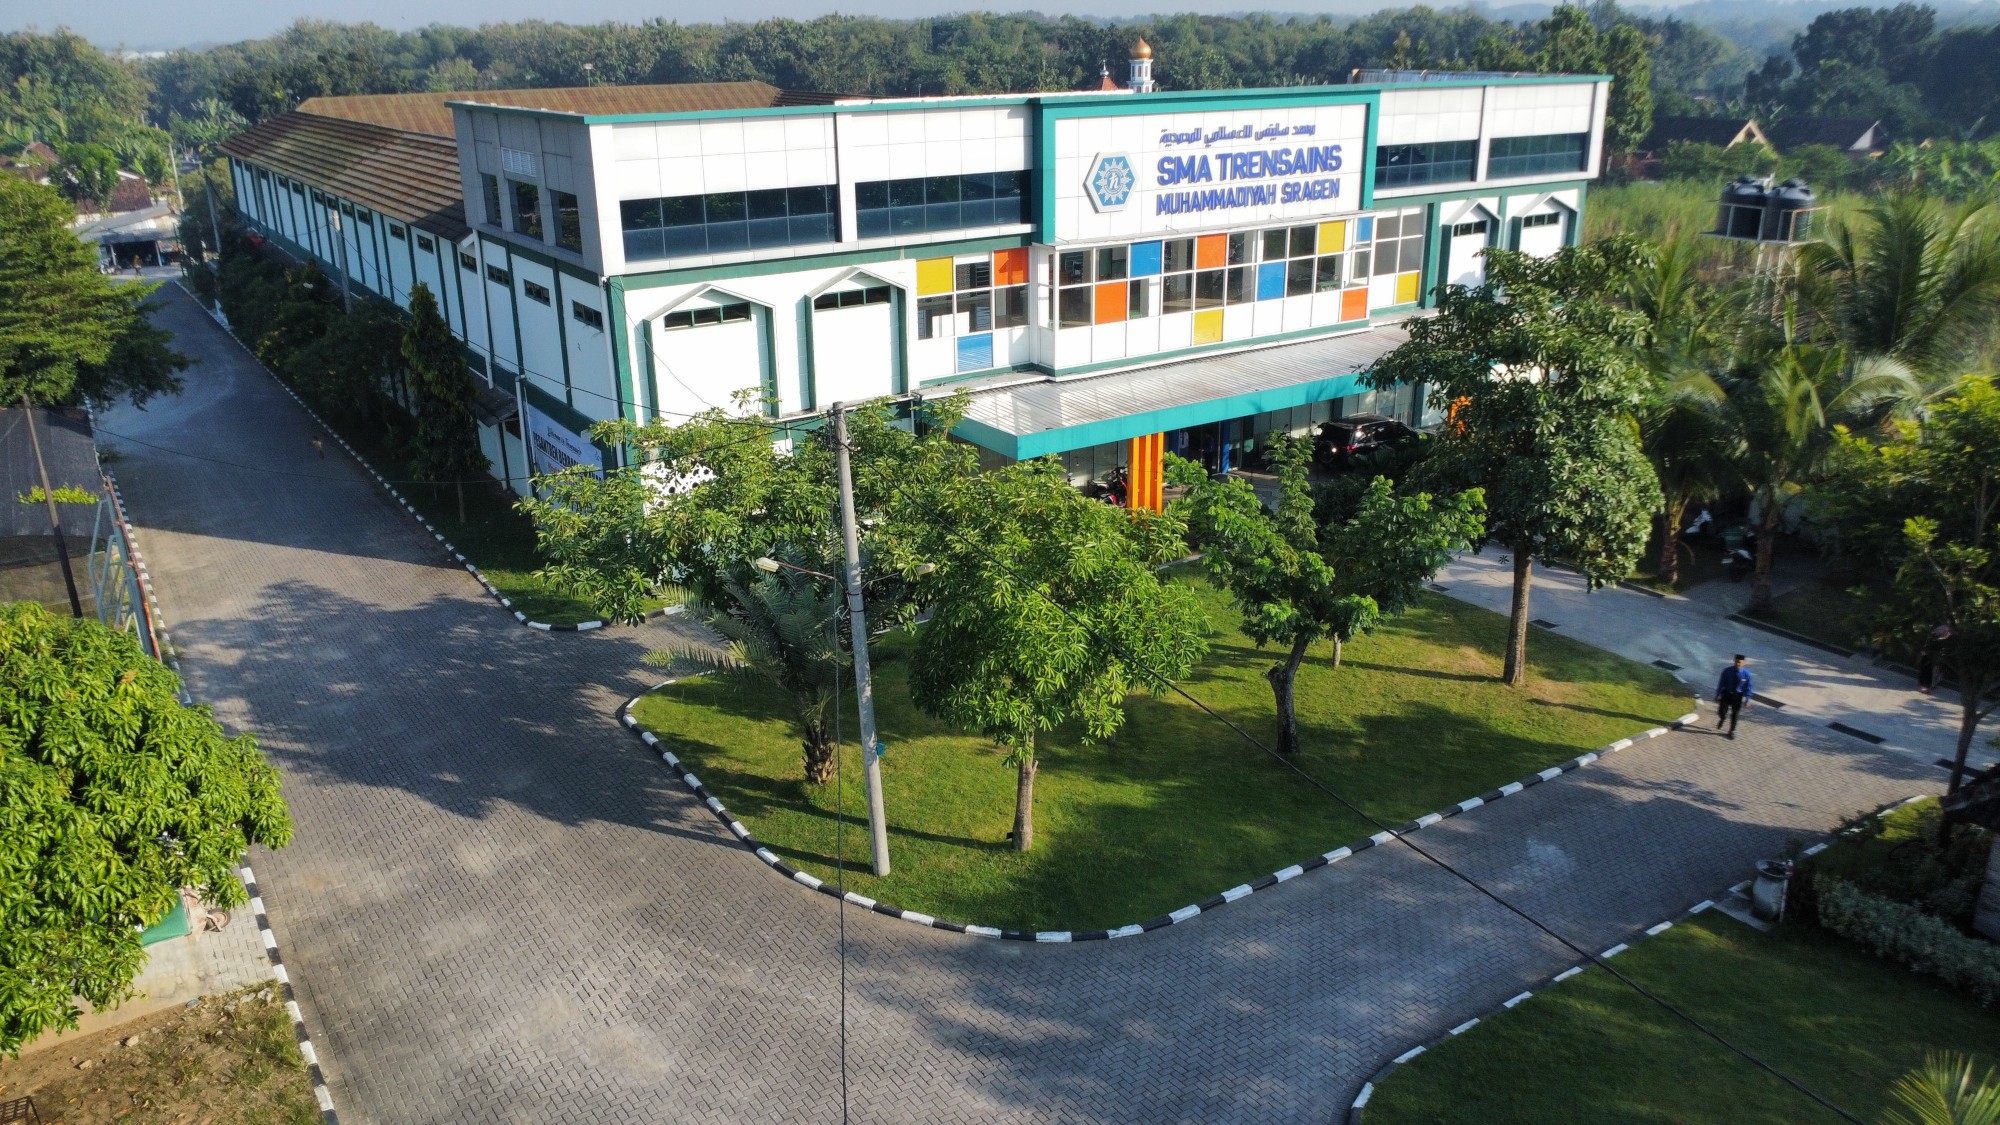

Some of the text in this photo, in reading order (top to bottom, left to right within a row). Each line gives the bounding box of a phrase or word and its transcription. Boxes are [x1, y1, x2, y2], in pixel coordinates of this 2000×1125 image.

[1157, 152, 1213, 186] SMA
[1216, 144, 1343, 179] TRENSAINS
[1156, 178, 1340, 216] MUHAMMADIYAH SRAGEN
